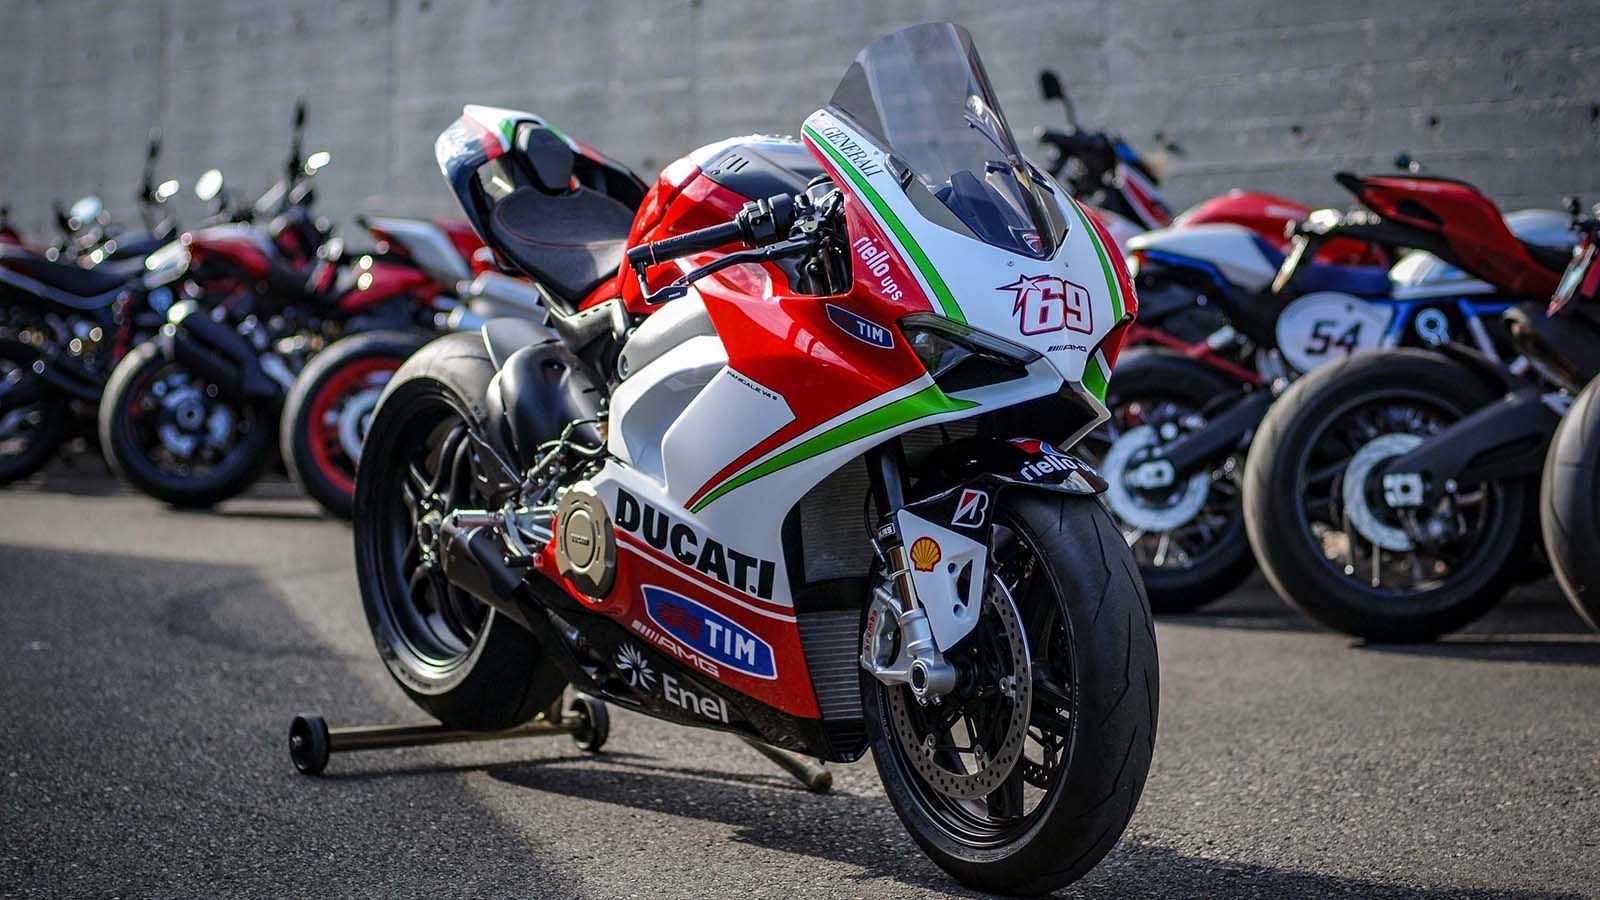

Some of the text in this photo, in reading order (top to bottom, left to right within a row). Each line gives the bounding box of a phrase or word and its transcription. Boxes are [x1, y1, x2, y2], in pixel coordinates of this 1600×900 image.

[821, 126, 884, 177] GENERALI
[853, 236, 903, 301] riello ups
[1019, 275, 1094, 336] 69
[857, 320, 884, 343] TIM
[1305, 319, 1363, 358] 54
[1020, 455, 1079, 481] riello
[614, 487, 776, 600] DUCATI
[704, 618, 756, 666] TIM
[662, 673, 729, 724] Enel
